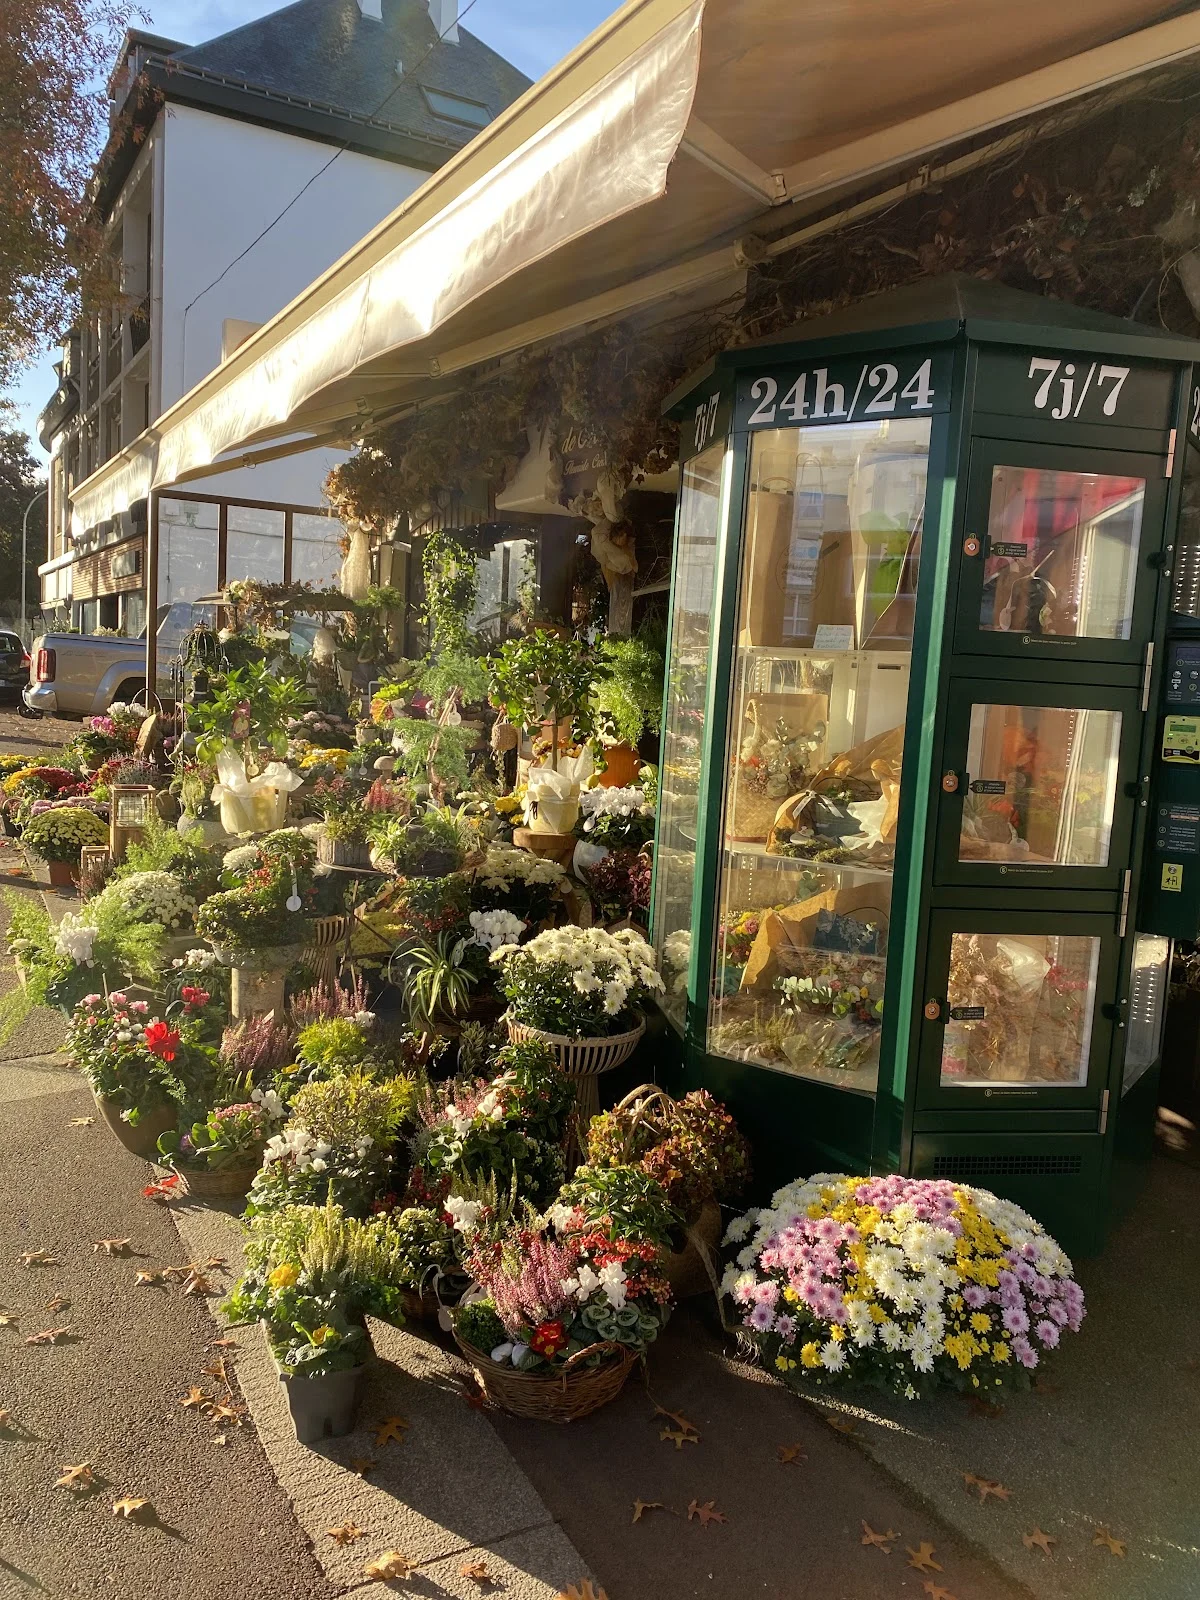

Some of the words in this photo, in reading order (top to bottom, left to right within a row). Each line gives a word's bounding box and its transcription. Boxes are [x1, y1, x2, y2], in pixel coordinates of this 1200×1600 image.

[748, 358, 935, 425] 24h/24
[1028, 357, 1130, 420] 7j/7
[694, 391, 721, 452] 7j/7
